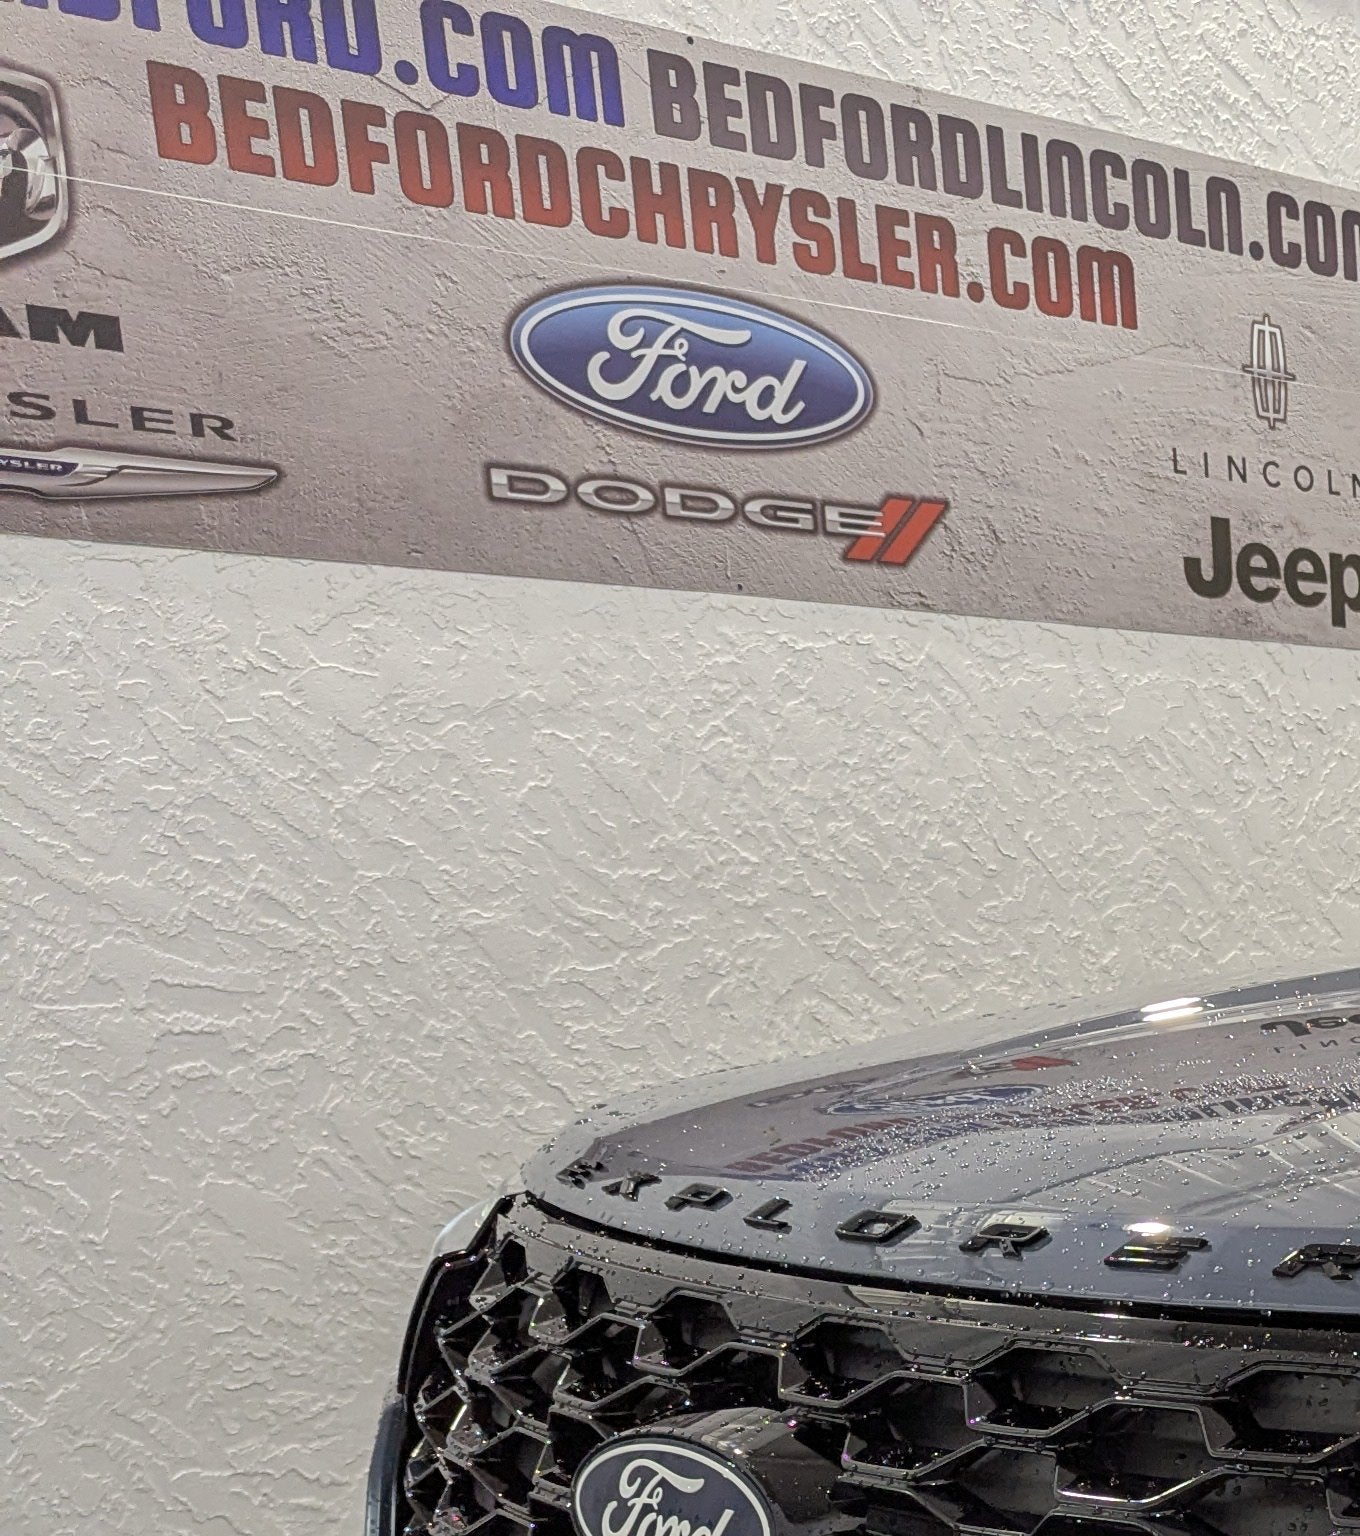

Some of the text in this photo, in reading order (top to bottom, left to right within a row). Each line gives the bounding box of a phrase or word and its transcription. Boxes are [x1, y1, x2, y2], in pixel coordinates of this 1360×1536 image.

[146, 59, 1137, 329] BEDFORDCHRYSLER.COM
[587, 308, 808, 425] Ford
[7, 391, 237, 442] SLER
[489, 467, 886, 538] DODGE
